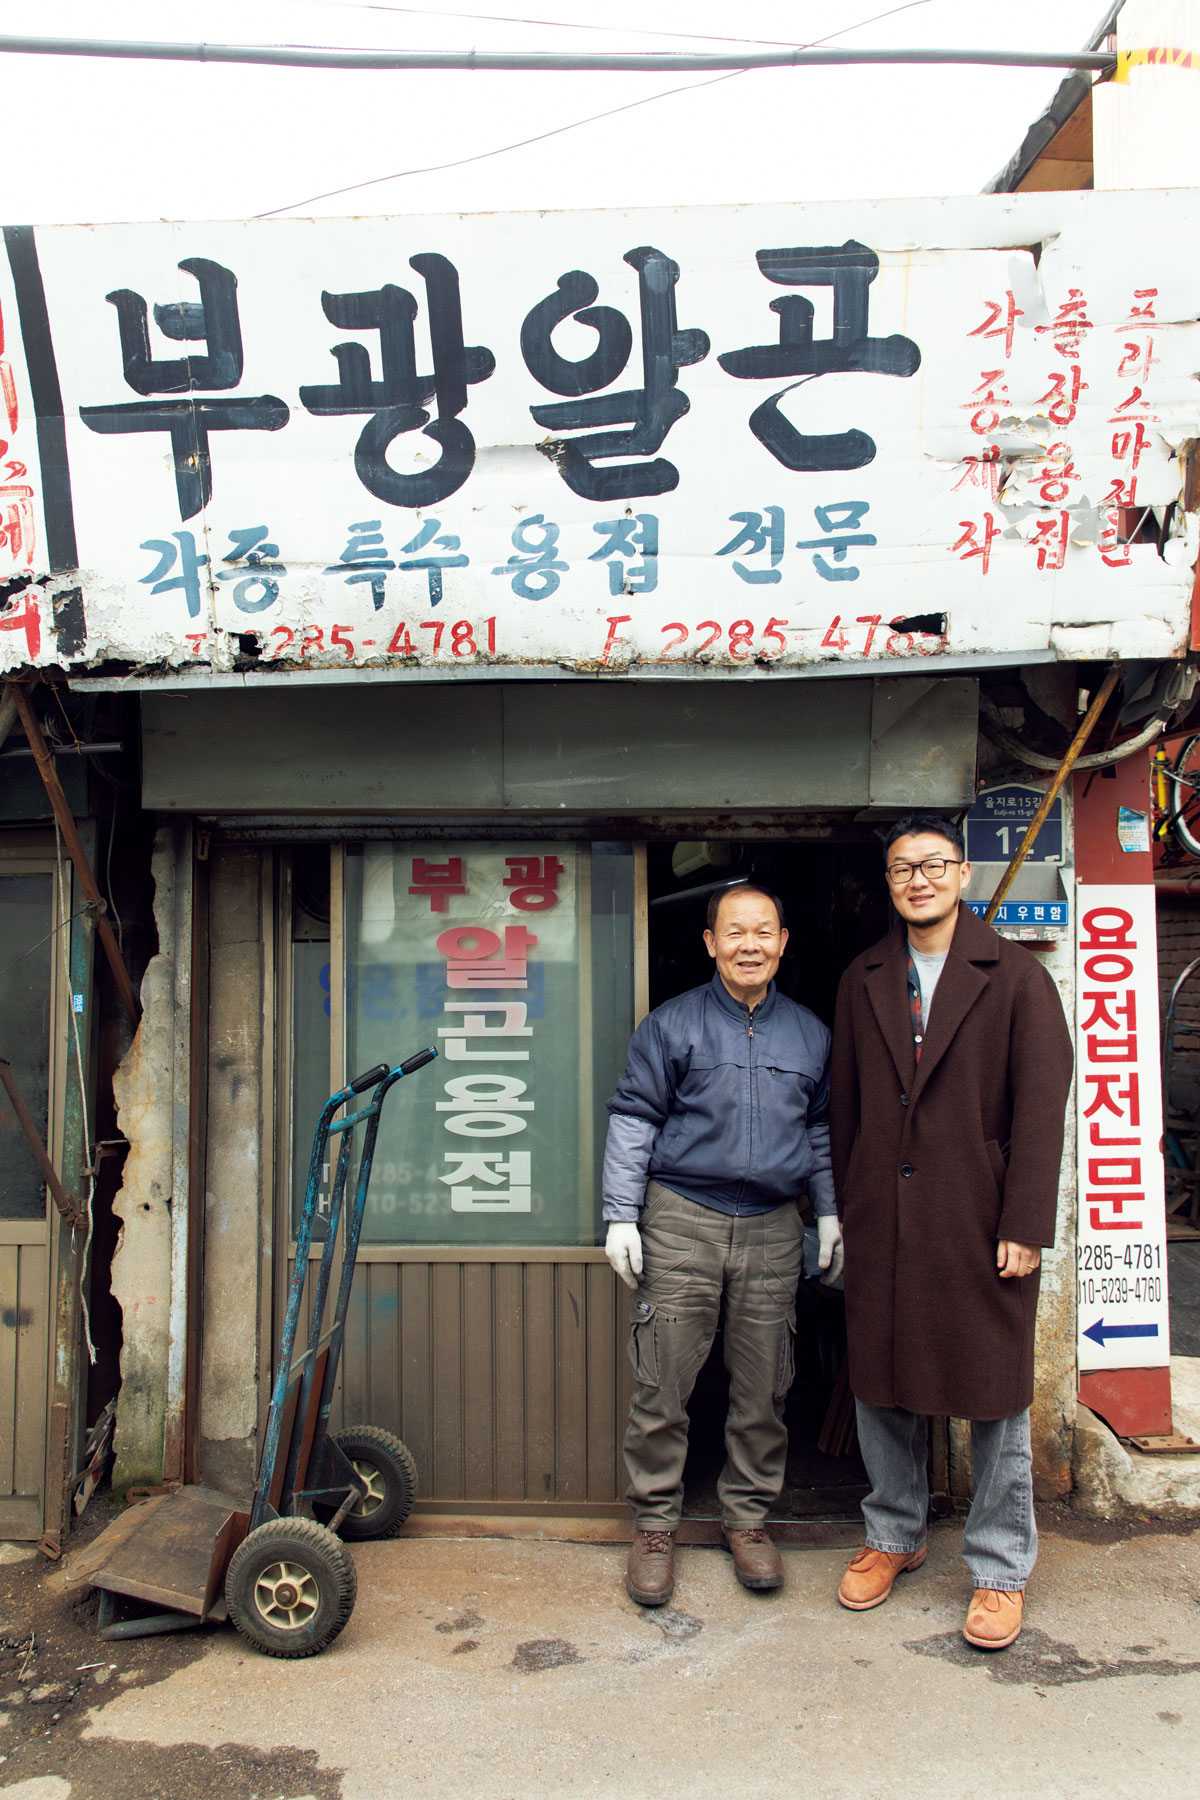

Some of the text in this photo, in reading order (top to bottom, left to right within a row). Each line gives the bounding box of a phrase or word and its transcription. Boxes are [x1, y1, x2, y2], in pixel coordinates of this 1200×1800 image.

[713, 501, 878, 585] 전문
[985, 796, 1042, 809] 을지로15길
[993, 809, 1035, 817] Eulji-ro 15-gil
[1017, 905, 1062, 921] 우편함
[436, 926, 538, 1213] 알곤용접
[1079, 906, 1146, 1231] 용접전문
[1078, 1276, 1162, 1305] 10-5239-4760
